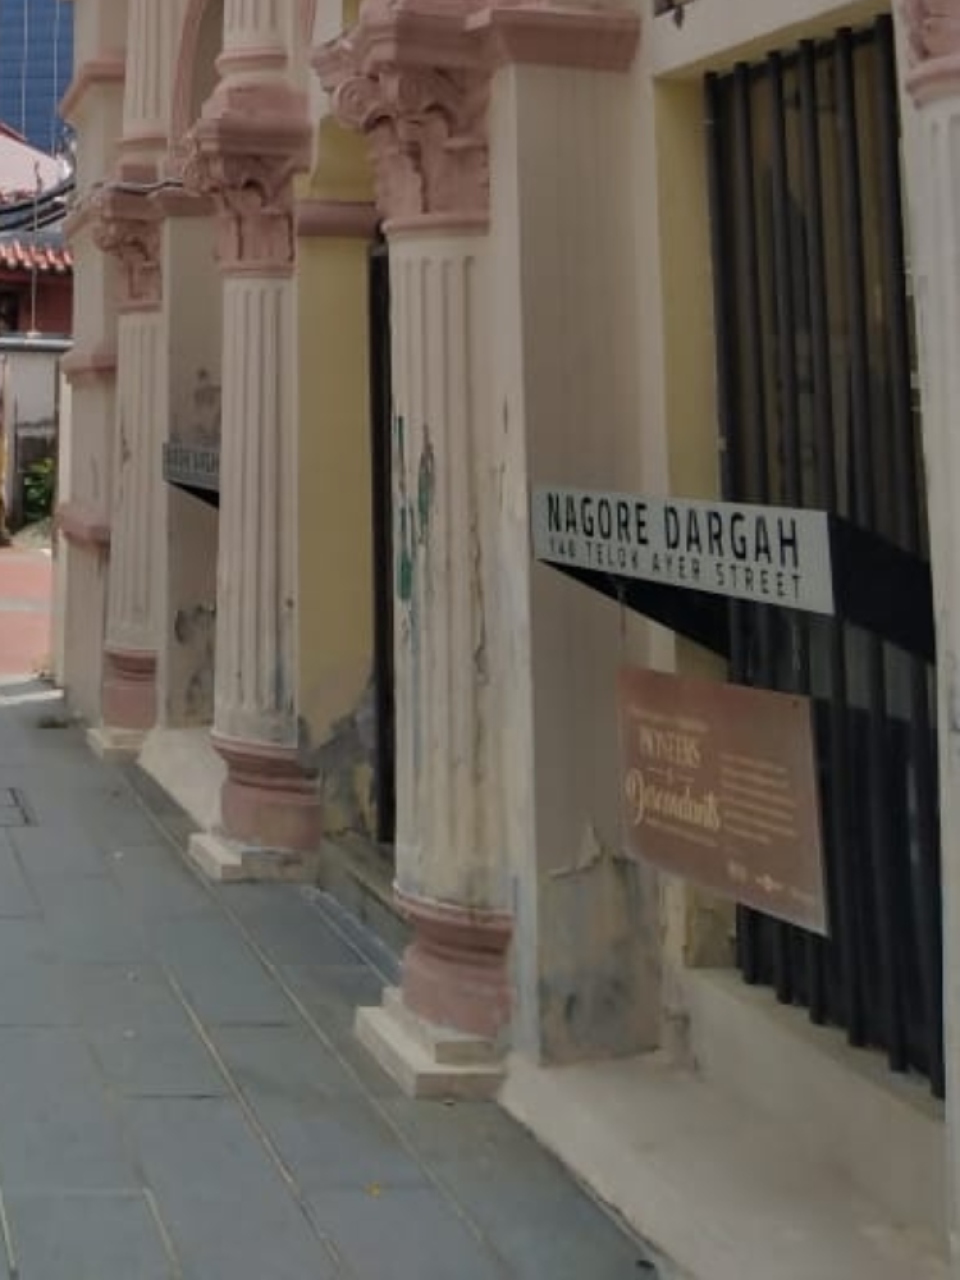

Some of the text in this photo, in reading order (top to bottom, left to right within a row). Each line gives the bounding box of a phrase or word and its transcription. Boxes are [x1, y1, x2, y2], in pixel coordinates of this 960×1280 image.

[547, 492, 799, 569] NAGORE DARGAH
[585, 540, 639, 570] TELOK
[652, 552, 701, 582] AYER
[715, 562, 801, 601] STREET
